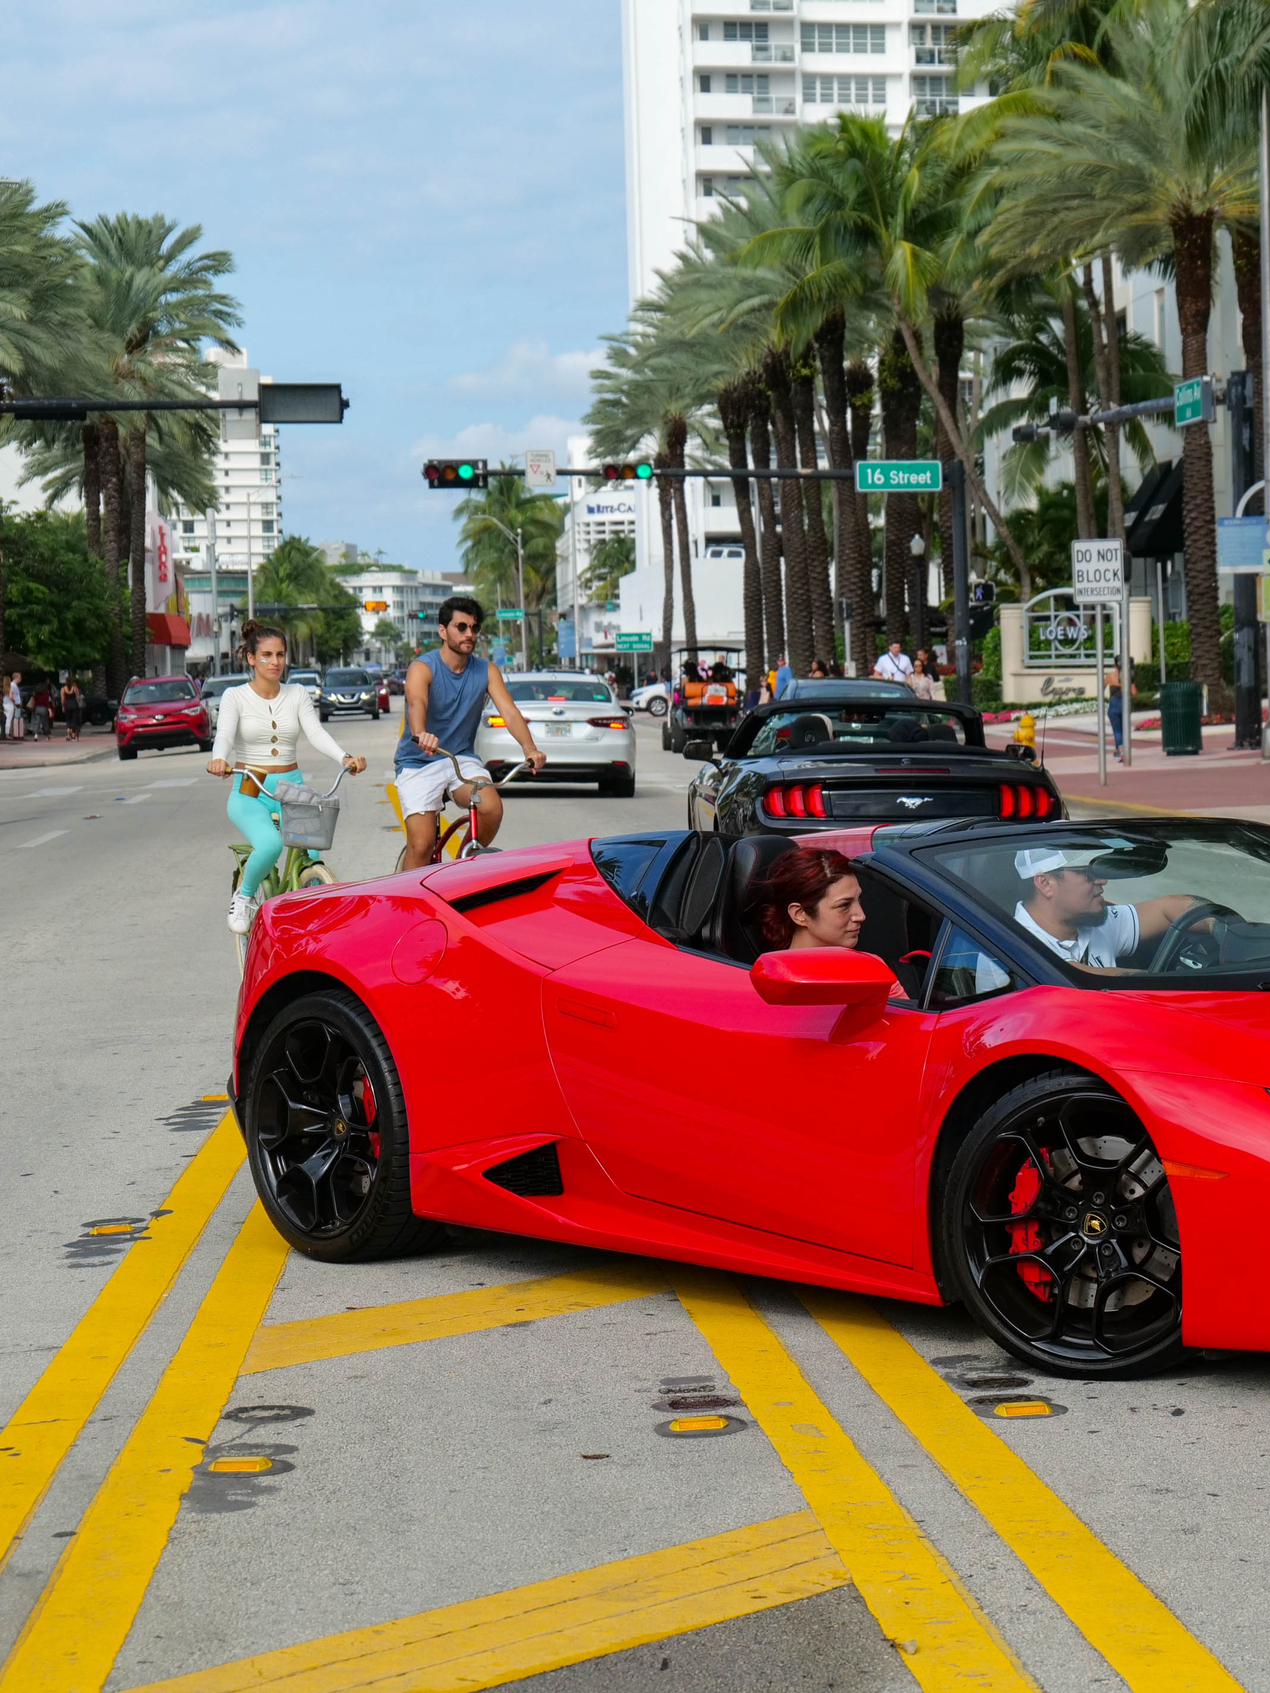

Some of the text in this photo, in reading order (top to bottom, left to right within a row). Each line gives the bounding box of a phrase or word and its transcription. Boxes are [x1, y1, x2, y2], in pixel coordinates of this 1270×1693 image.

[867, 468, 931, 484] 16 Street
[1076, 548, 1119, 563] DO NOT
[1077, 568, 1120, 583] BLOCK
[1076, 586, 1121, 597] INTERSECTION
[1040, 624, 1089, 640] LOEWS
